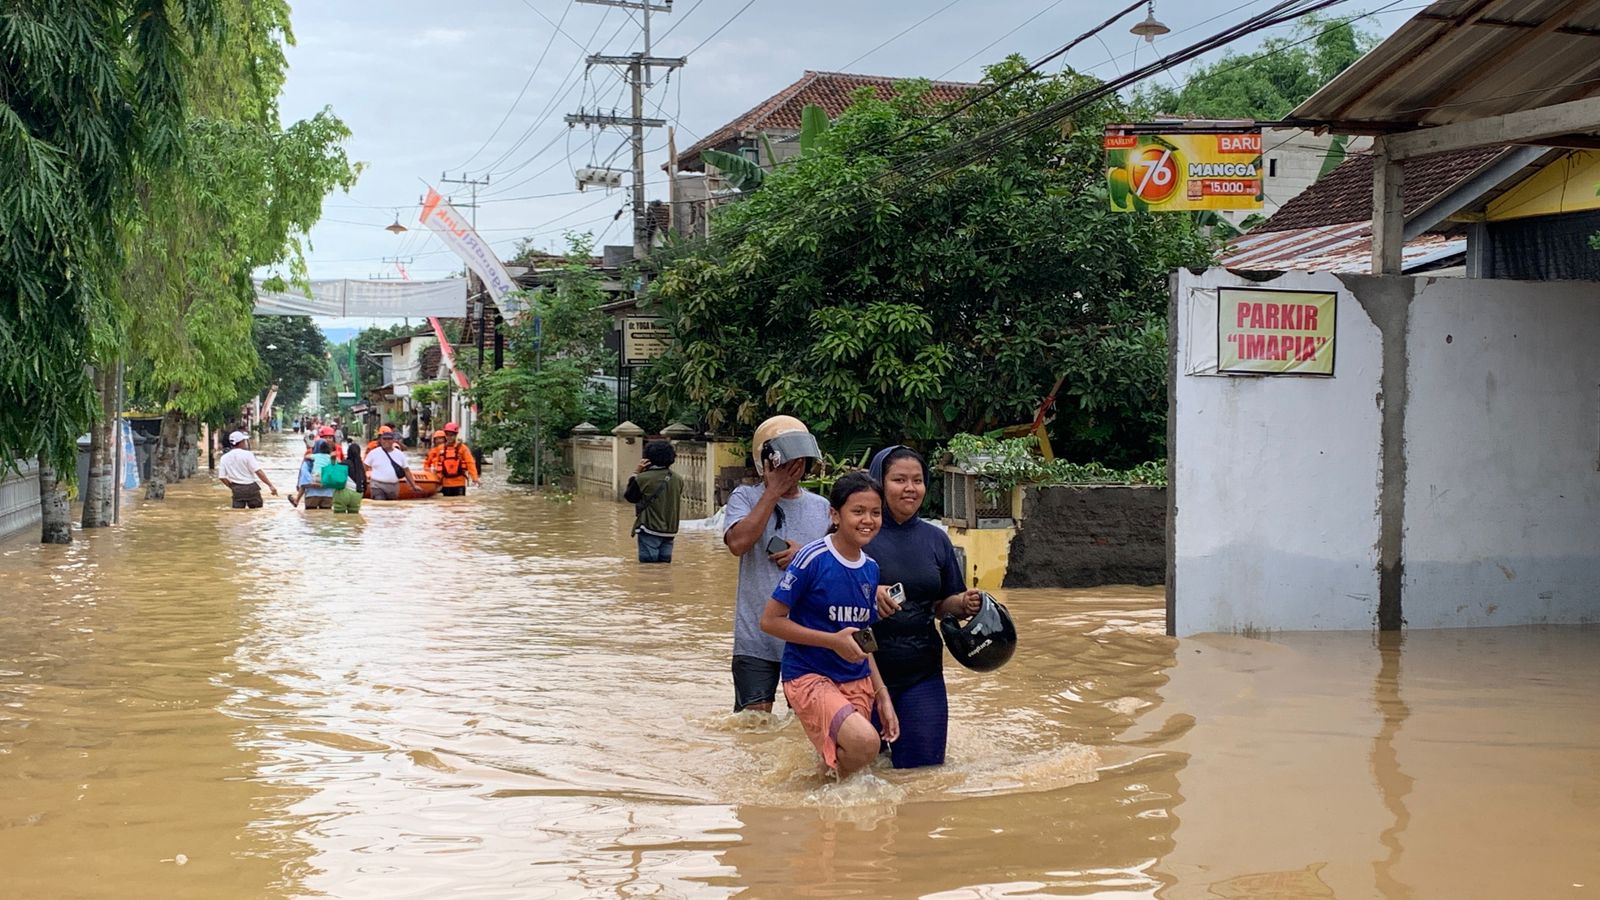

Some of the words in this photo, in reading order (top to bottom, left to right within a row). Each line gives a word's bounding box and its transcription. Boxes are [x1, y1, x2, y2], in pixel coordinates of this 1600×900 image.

[1221, 138, 1261, 150] BARU
[1138, 149, 1172, 197] 76
[1188, 162, 1257, 177] MANGGA
[1210, 182, 1244, 193] 15.000
[1236, 302, 1319, 331] PARKIR
